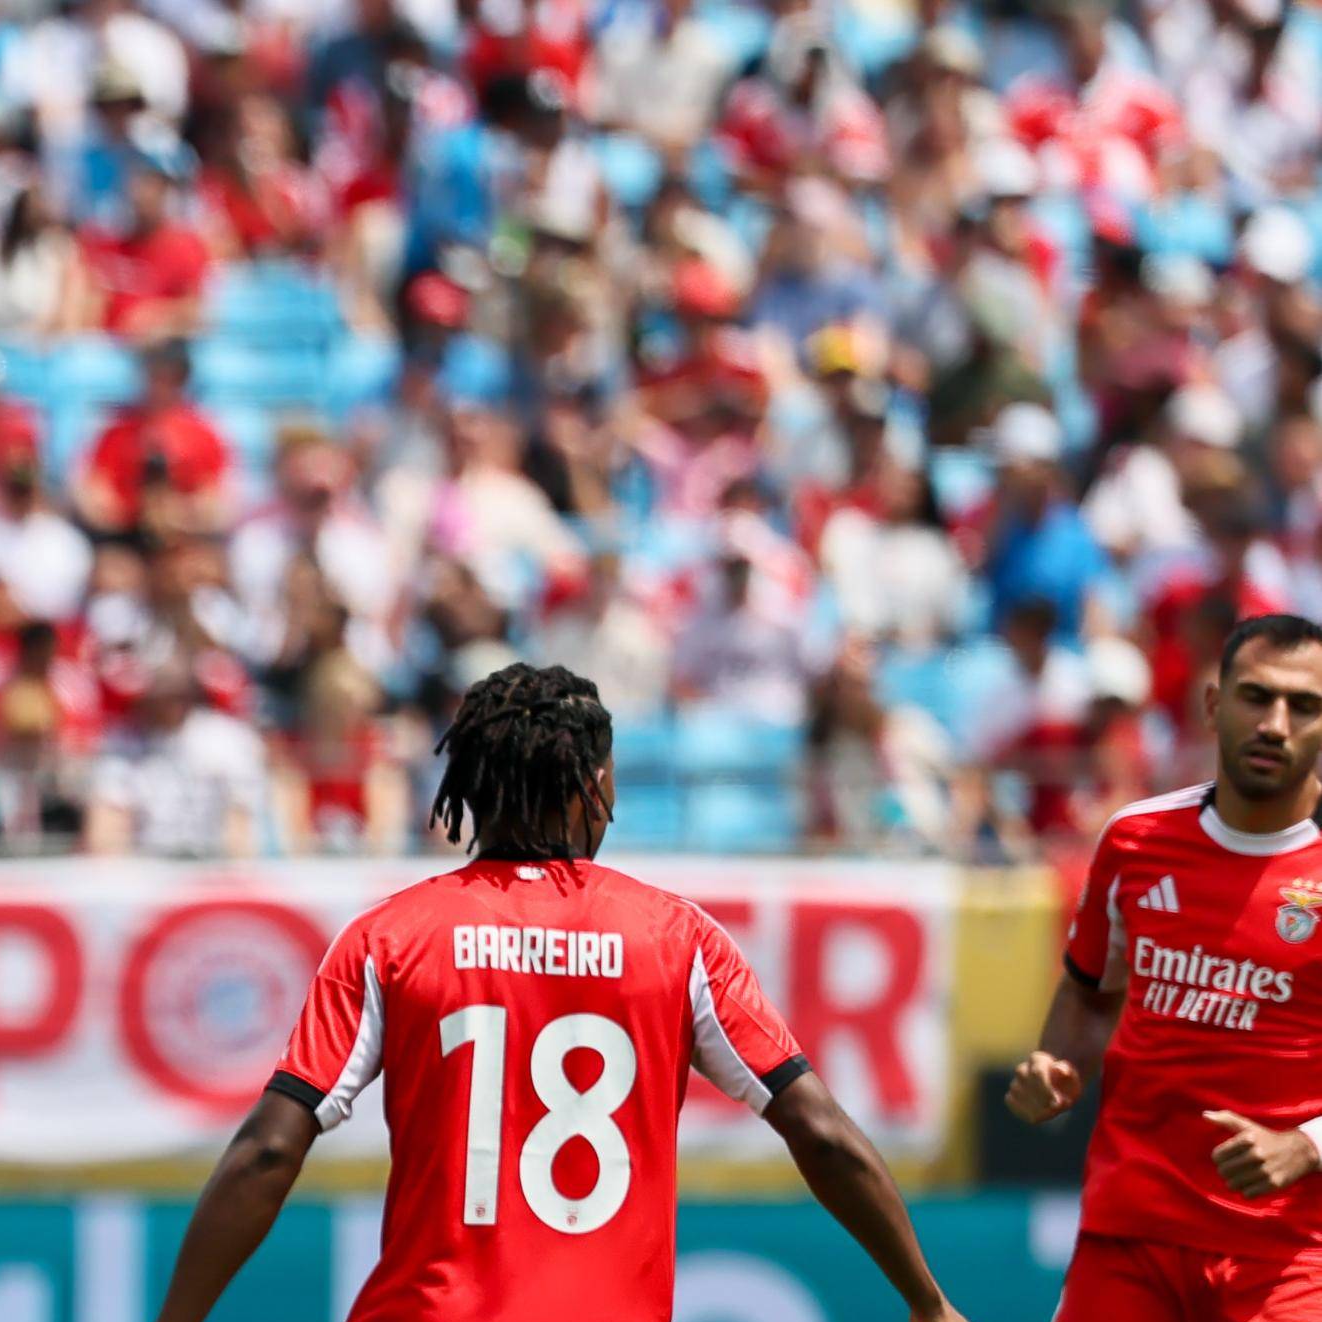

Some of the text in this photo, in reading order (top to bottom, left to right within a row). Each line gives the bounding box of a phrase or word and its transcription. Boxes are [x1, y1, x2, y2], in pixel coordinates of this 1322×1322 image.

[453, 924, 624, 979] BARREIRO
[1134, 935, 1294, 1003] Emirates
[1142, 980, 1260, 1031] FLY BETTER
[438, 1004, 637, 1235] 18
